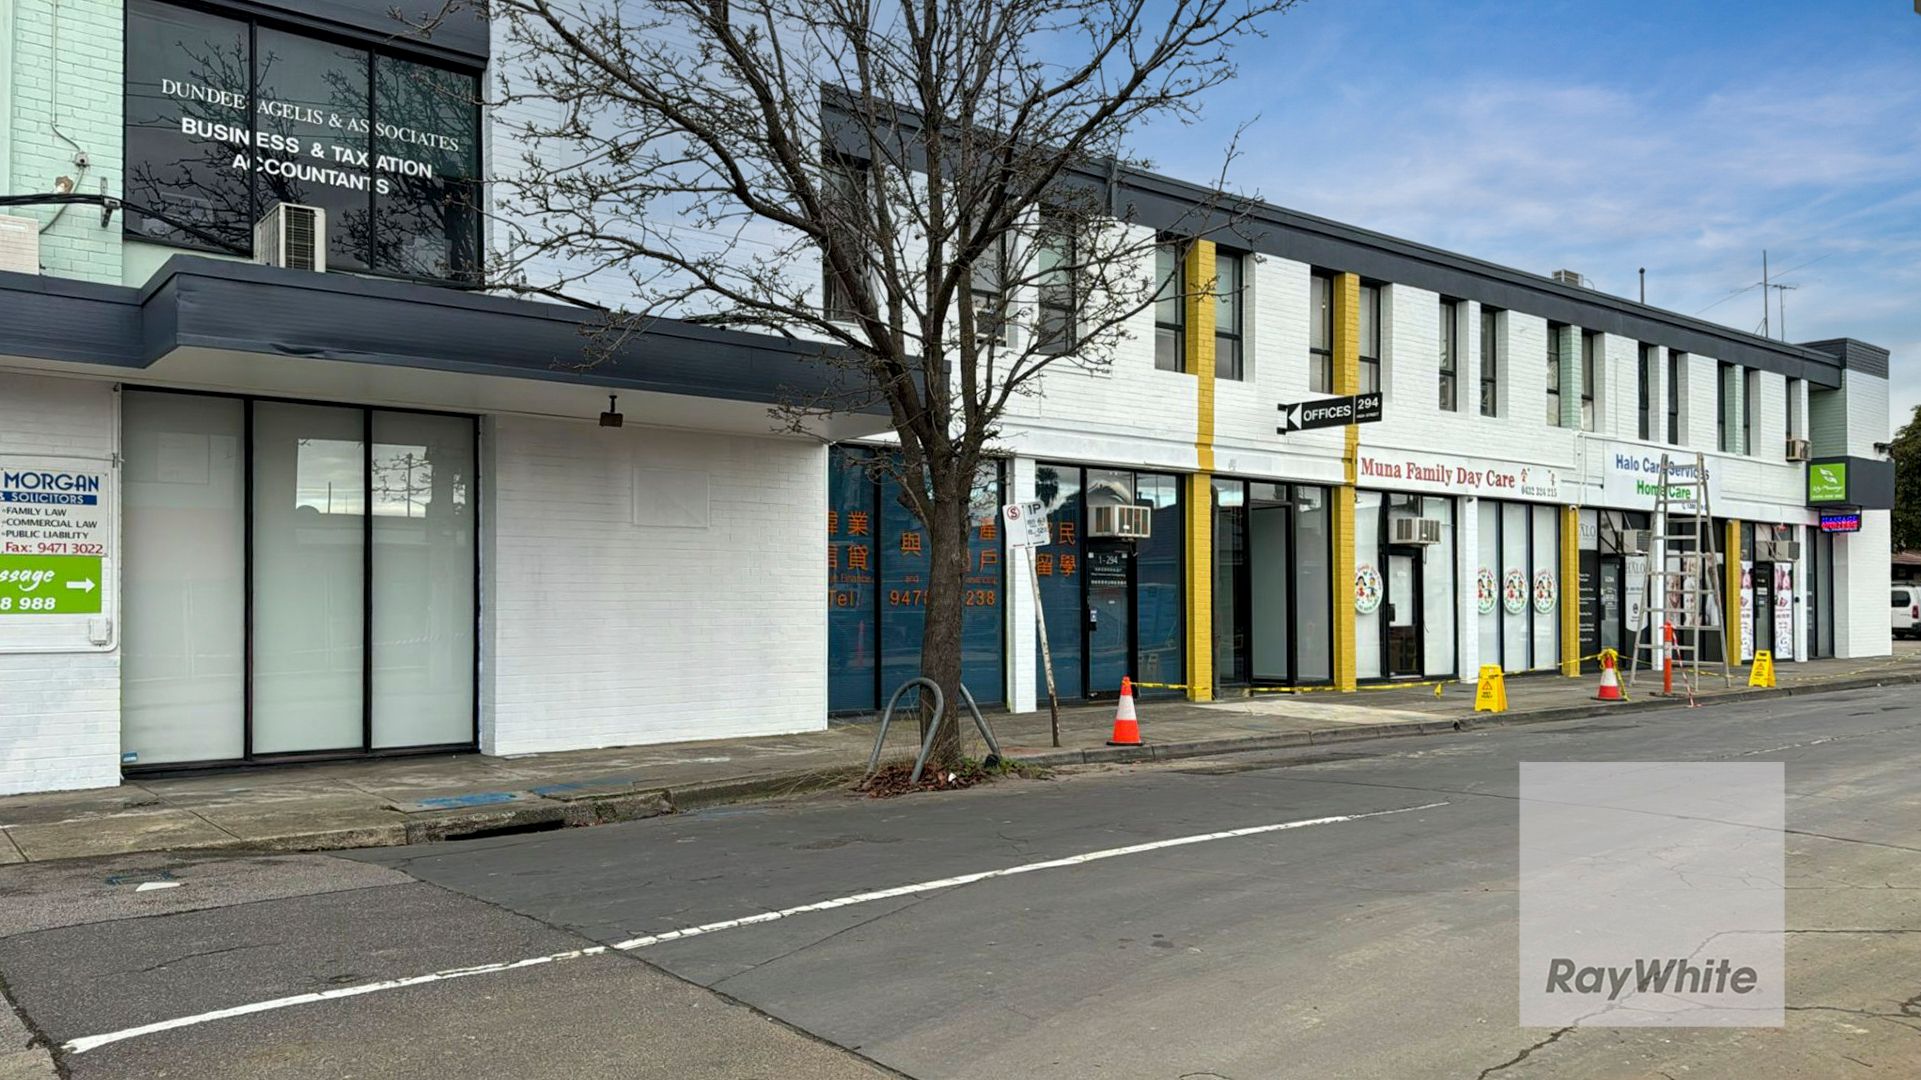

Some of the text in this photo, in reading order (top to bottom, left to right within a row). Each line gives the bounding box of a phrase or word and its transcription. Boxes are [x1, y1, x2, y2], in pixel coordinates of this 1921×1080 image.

[161, 78, 459, 152] DUNDEE AGELIS & ASSOCIATES
[181, 117, 433, 179] BUSINESS & TAXATION
[1303, 397, 1379, 422] OFFICES 294
[1361, 457, 1515, 489] Muna Family Day Care
[1616, 454, 1710, 480] Halo Car Servics
[4, 472, 99, 492] MORGAN
[11, 492, 85, 504] SOLICITORS
[1669, 485, 1691, 500] Care
[6, 507, 67, 517] FAMILY LAW
[1028, 503, 1041, 515] 1P
[6, 519, 98, 529] COMMERCIAL LAW
[1580, 525, 1596, 537] ALO
[6, 530, 89, 540] PUBLIC LIABILITY
[1058, 521, 1076, 546] 民
[5, 542, 104, 554] Fax: 9471 3022
[18, 597, 57, 610] 988
[964, 590, 996, 607] 238
